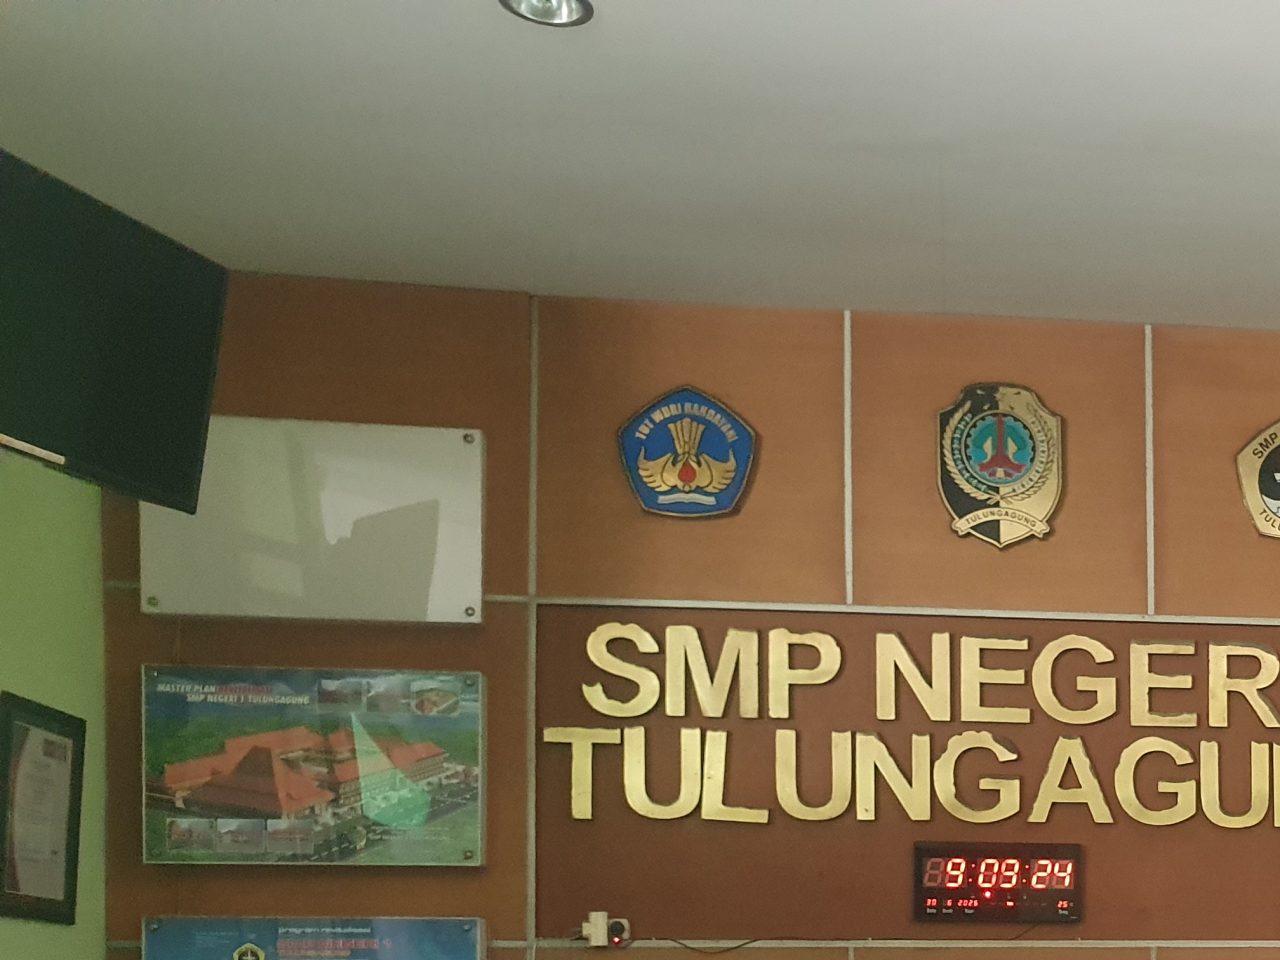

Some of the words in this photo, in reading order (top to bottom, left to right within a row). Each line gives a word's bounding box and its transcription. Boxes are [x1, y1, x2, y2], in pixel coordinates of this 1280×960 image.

[635, 418, 654, 440] TUT
[651, 402, 682, 423] WURI
[684, 402, 738, 442] HANDAYANI
[1252, 432, 1279, 459] SMP
[966, 510, 1036, 528] TULUNGAGUNG
[582, 622, 842, 719] SMP
[946, 858, 1072, 888] 9:09:24
